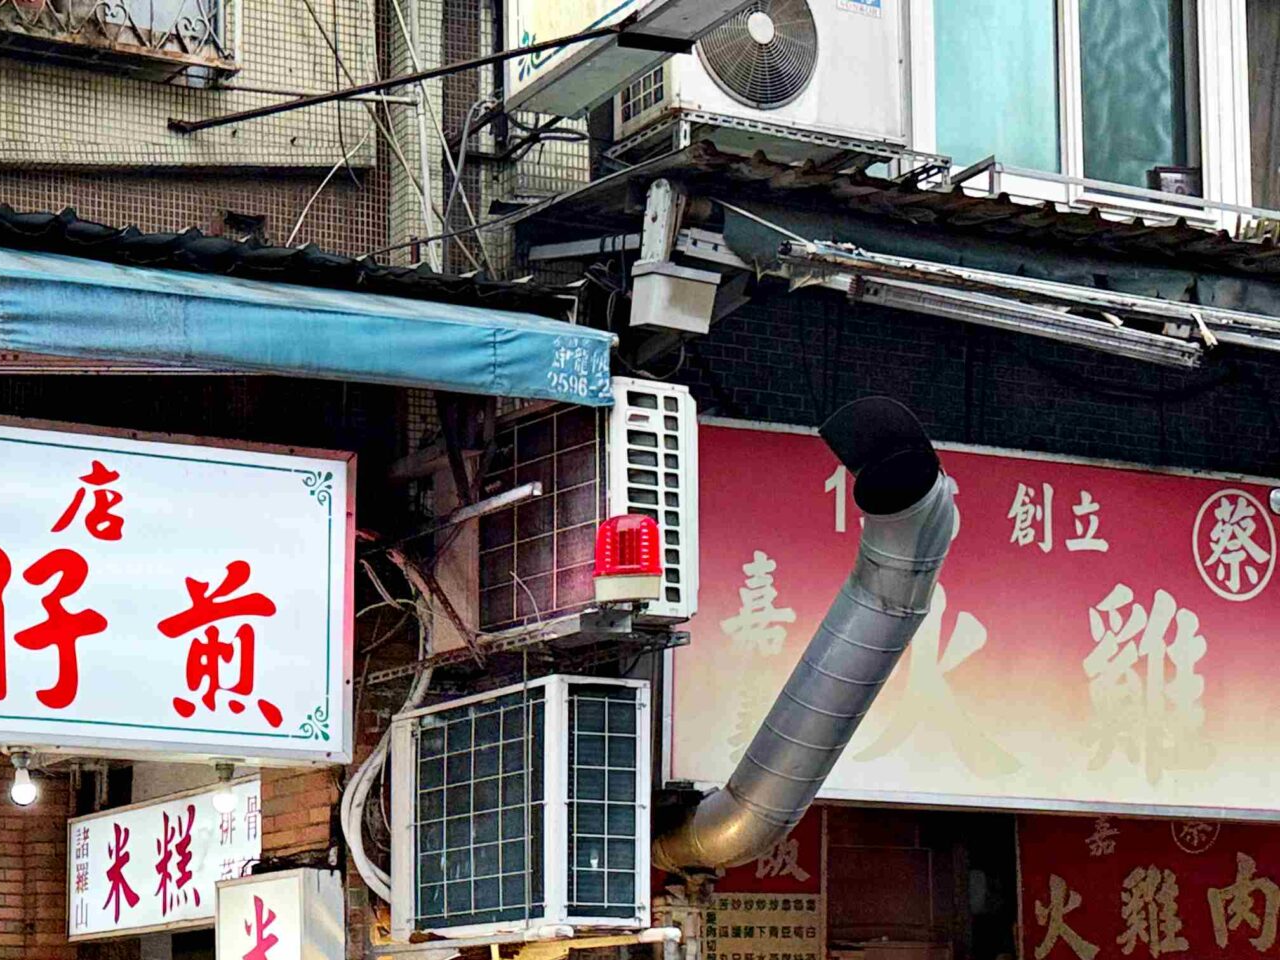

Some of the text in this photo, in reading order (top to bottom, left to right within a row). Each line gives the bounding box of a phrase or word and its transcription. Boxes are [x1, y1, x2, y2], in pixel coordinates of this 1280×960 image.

[1008, 482, 1109, 553] 創立
[1204, 495, 1271, 593] 蔡
[103, 803, 201, 924] 米糕
